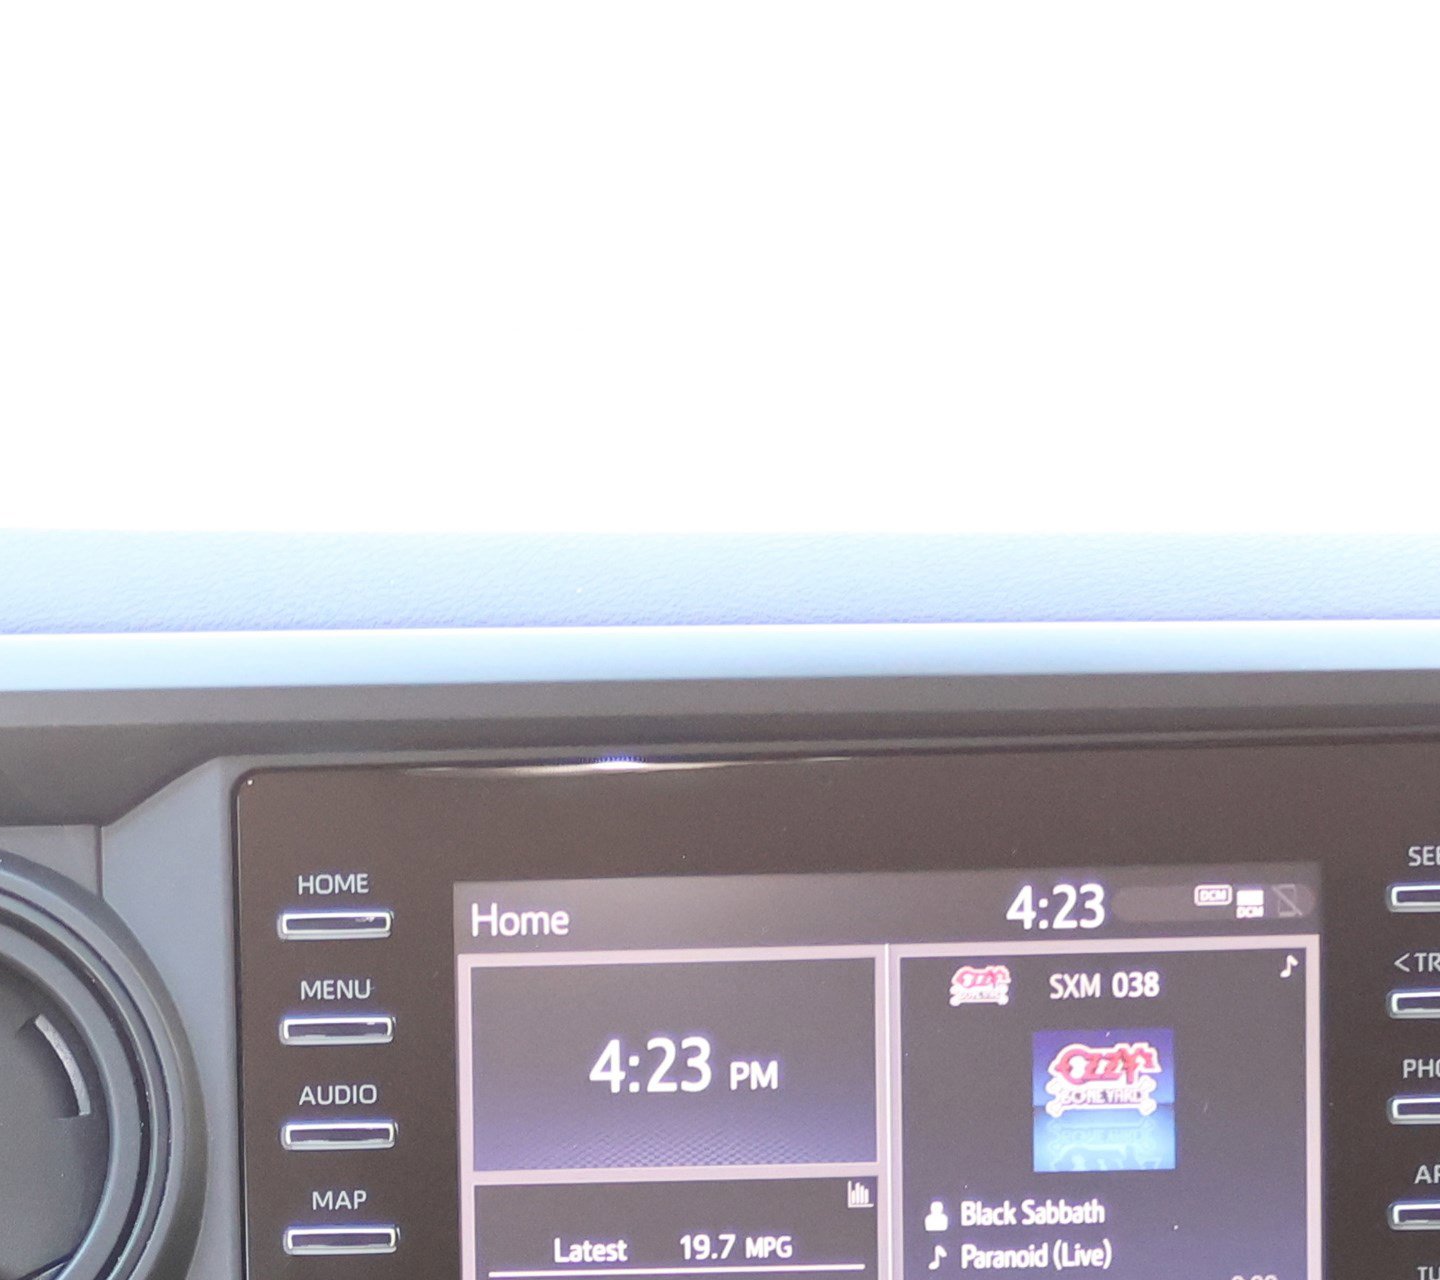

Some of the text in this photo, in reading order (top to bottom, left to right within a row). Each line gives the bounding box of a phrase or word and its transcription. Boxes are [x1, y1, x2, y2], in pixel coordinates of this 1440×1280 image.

[297, 874, 369, 894] HOME
[470, 902, 570, 937] Home
[1006, 885, 1106, 929] 4:23
[300, 980, 372, 1000] MENU
[1049, 972, 1161, 999] SXM 038
[589, 1037, 778, 1094] 4:23 PM
[299, 1084, 378, 1106] AUDIO
[311, 1191, 367, 1210] MAP
[960, 1198, 1105, 1226] Black Sabbath
[553, 1235, 792, 1263] Latest 19.7 MPG
[960, 1238, 1112, 1271] Paranoid (Live)
